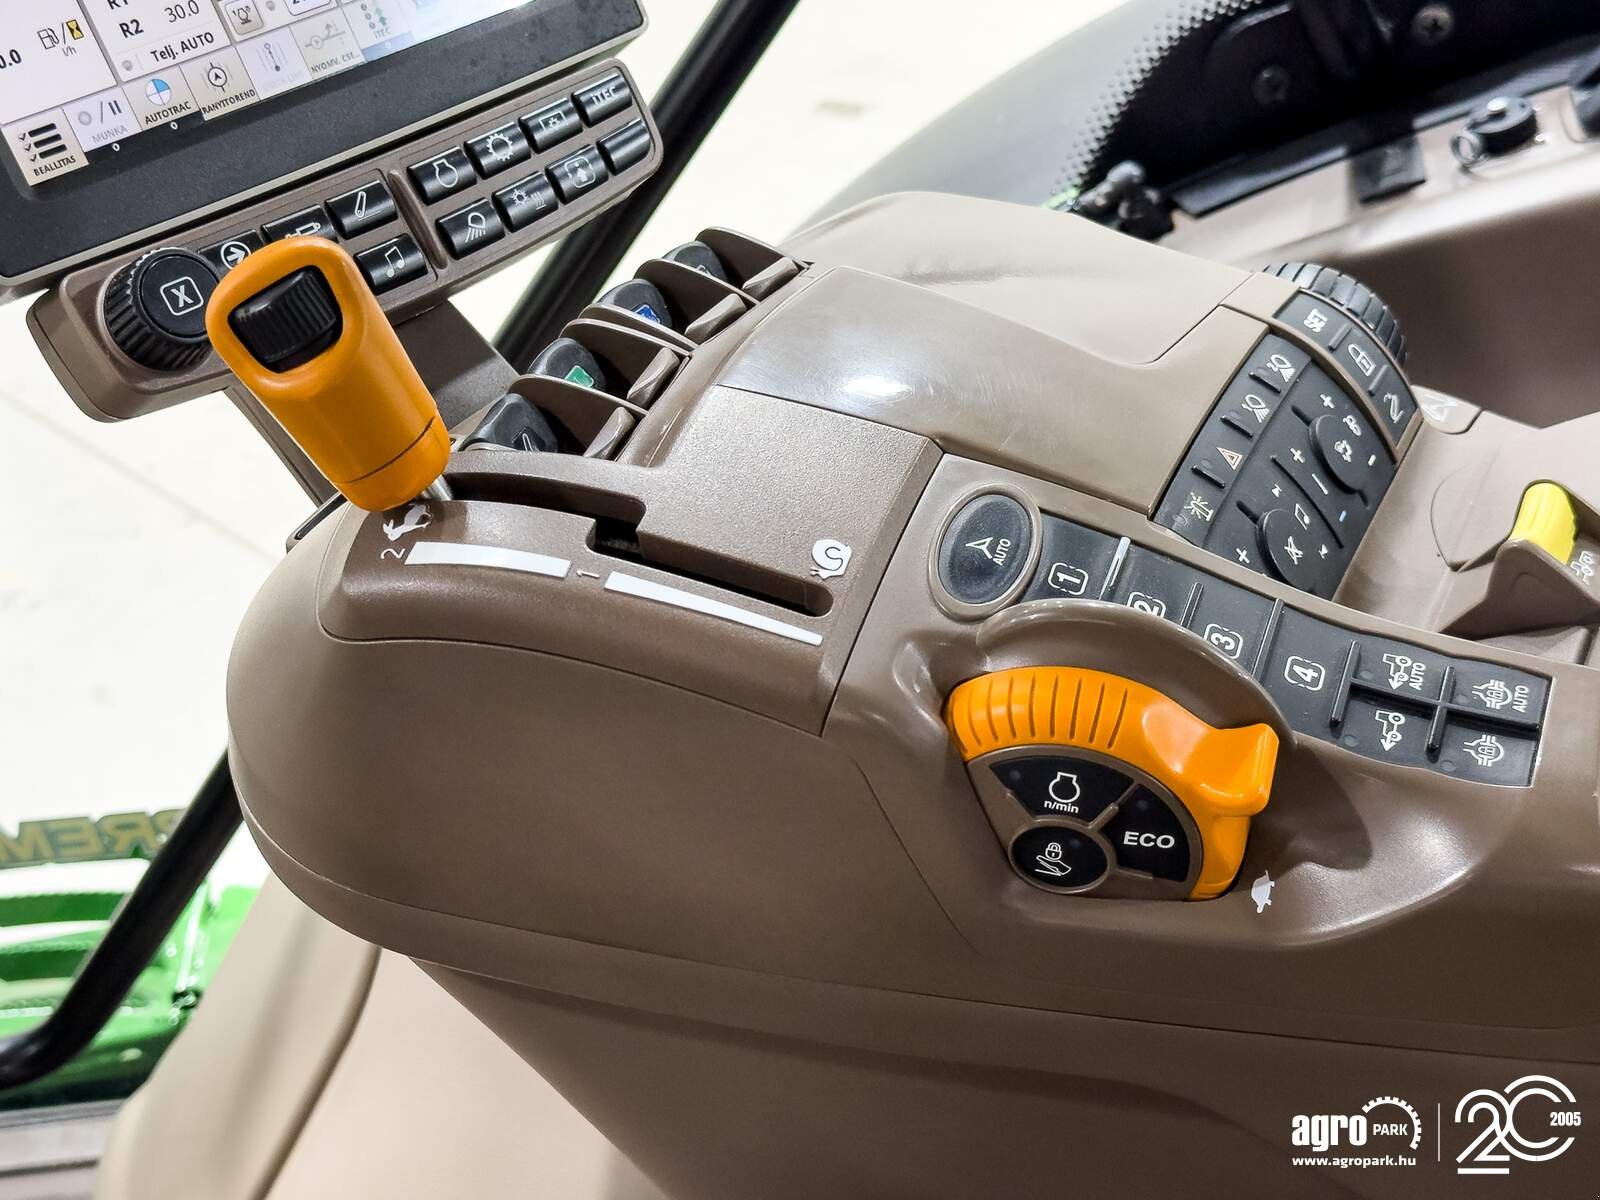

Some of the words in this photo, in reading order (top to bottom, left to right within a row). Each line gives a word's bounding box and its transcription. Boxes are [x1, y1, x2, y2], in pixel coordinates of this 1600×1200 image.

[164, 0, 200, 23] 30.0
[119, 18, 144, 38] R2
[150, 44, 179, 62] Telj.
[180, 31, 215, 54] AUTO
[145, 101, 192, 126] AUTOTRAC
[91, 125, 129, 145] MUNKA
[33, 154, 77, 178] BEALLITAS
[1303, 308, 1329, 333] SET
[380, 546, 407, 560] 2
[991, 537, 1012, 566] AUTO
[1058, 570, 1082, 586] 1
[1210, 630, 1236, 651] 3
[1293, 665, 1319, 682] 4
[1408, 661, 1427, 691] AUTO
[1511, 684, 1530, 713] AUTO
[1043, 799, 1079, 815] n/min
[1122, 830, 1176, 850] ECO
